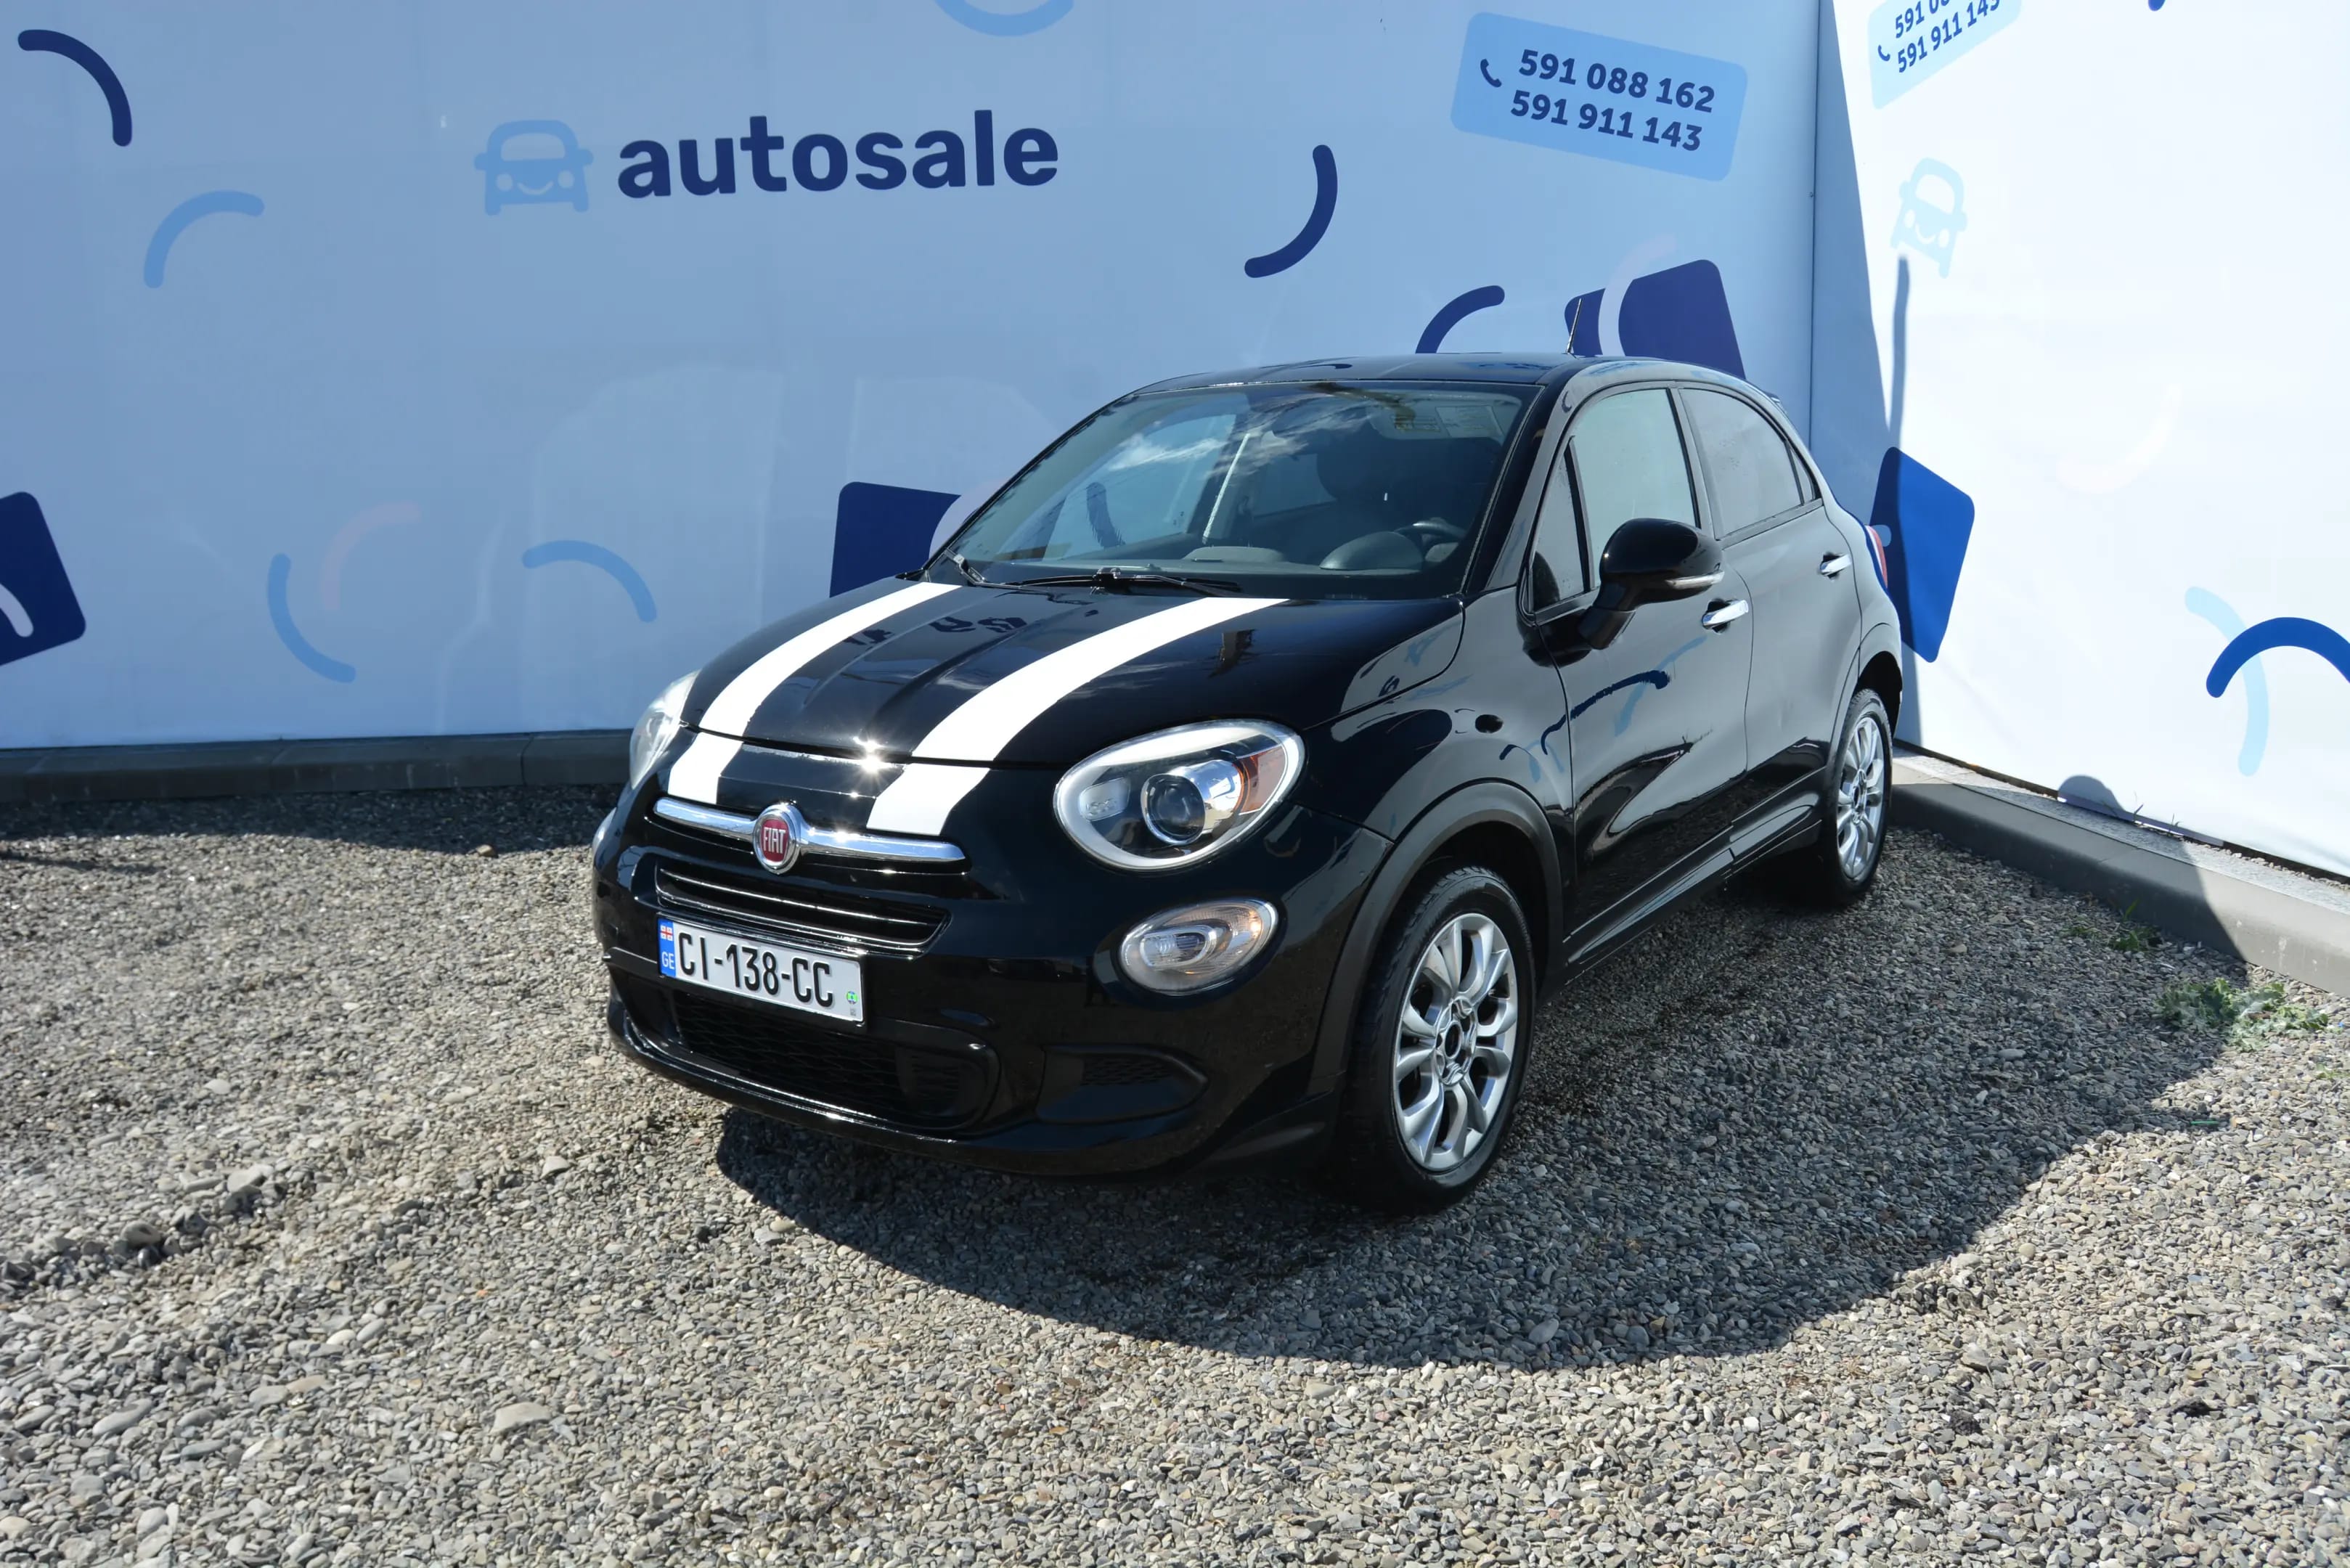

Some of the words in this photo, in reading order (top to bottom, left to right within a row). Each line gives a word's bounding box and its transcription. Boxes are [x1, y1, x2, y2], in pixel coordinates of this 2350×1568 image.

[1896, 1, 1925, 38] 591
[1898, 36, 1927, 73] 591
[1930, 12, 1962, 51] 911
[1518, 49, 1577, 86] 591
[1586, 62, 1649, 99] 088
[1655, 78, 1715, 113] 162
[1510, 89, 1568, 126] 591
[1578, 103, 1633, 139] 911
[1642, 117, 1702, 151] 143
[618, 110, 1058, 199] autosale
[762, 826, 787, 854] FIAT
[661, 951, 674, 971] GE
[678, 932, 833, 1008] CI-138-CC
